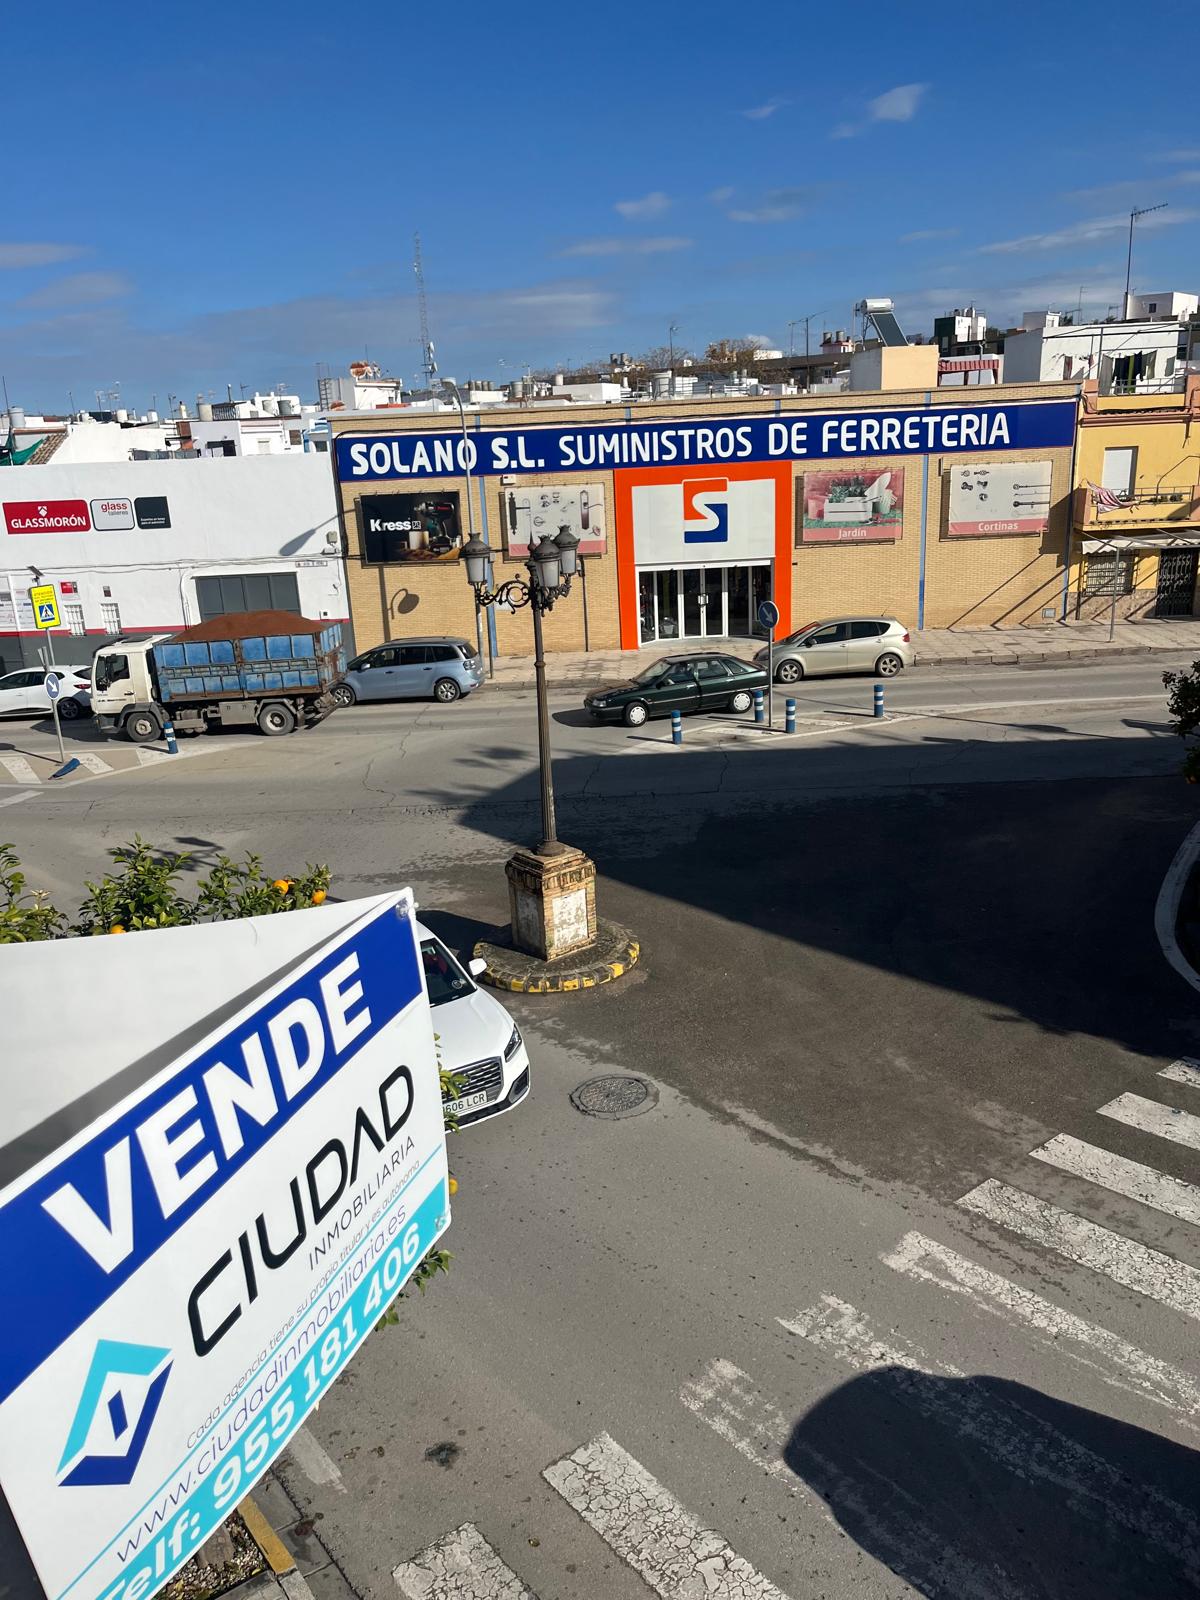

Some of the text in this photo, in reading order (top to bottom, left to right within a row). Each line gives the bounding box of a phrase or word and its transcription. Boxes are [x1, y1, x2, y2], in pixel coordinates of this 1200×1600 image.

[350, 412, 1010, 476] SOLANO S.L. SUMINISTROS DE FERRETERIA
[11, 514, 86, 529] GLASSMORÓN
[101, 502, 128, 513] glass
[370, 518, 411, 532] Kress
[838, 527, 867, 539] Jardín
[978, 521, 1019, 531] Cortinas
[40, 951, 372, 1275] VENDE
[443, 1093, 485, 1113] 606 LCR
[187, 1064, 415, 1358] CIUDAD
[309, 1135, 415, 1271] INMOBILIARIA
[223, 1350, 267, 1407] agencia
[269, 1315, 295, 1350] tiene
[296, 1299, 308, 1317] su
[310, 1260, 339, 1304] propio
[340, 1226, 364, 1262] titular
[371, 1207, 381, 1222] es
[117, 1205, 406, 1562] www.ciudadinmobiliaria.es
[213, 1384, 295, 1510] 955
[303, 1305, 358, 1402] 181
[364, 1222, 420, 1318] 406
